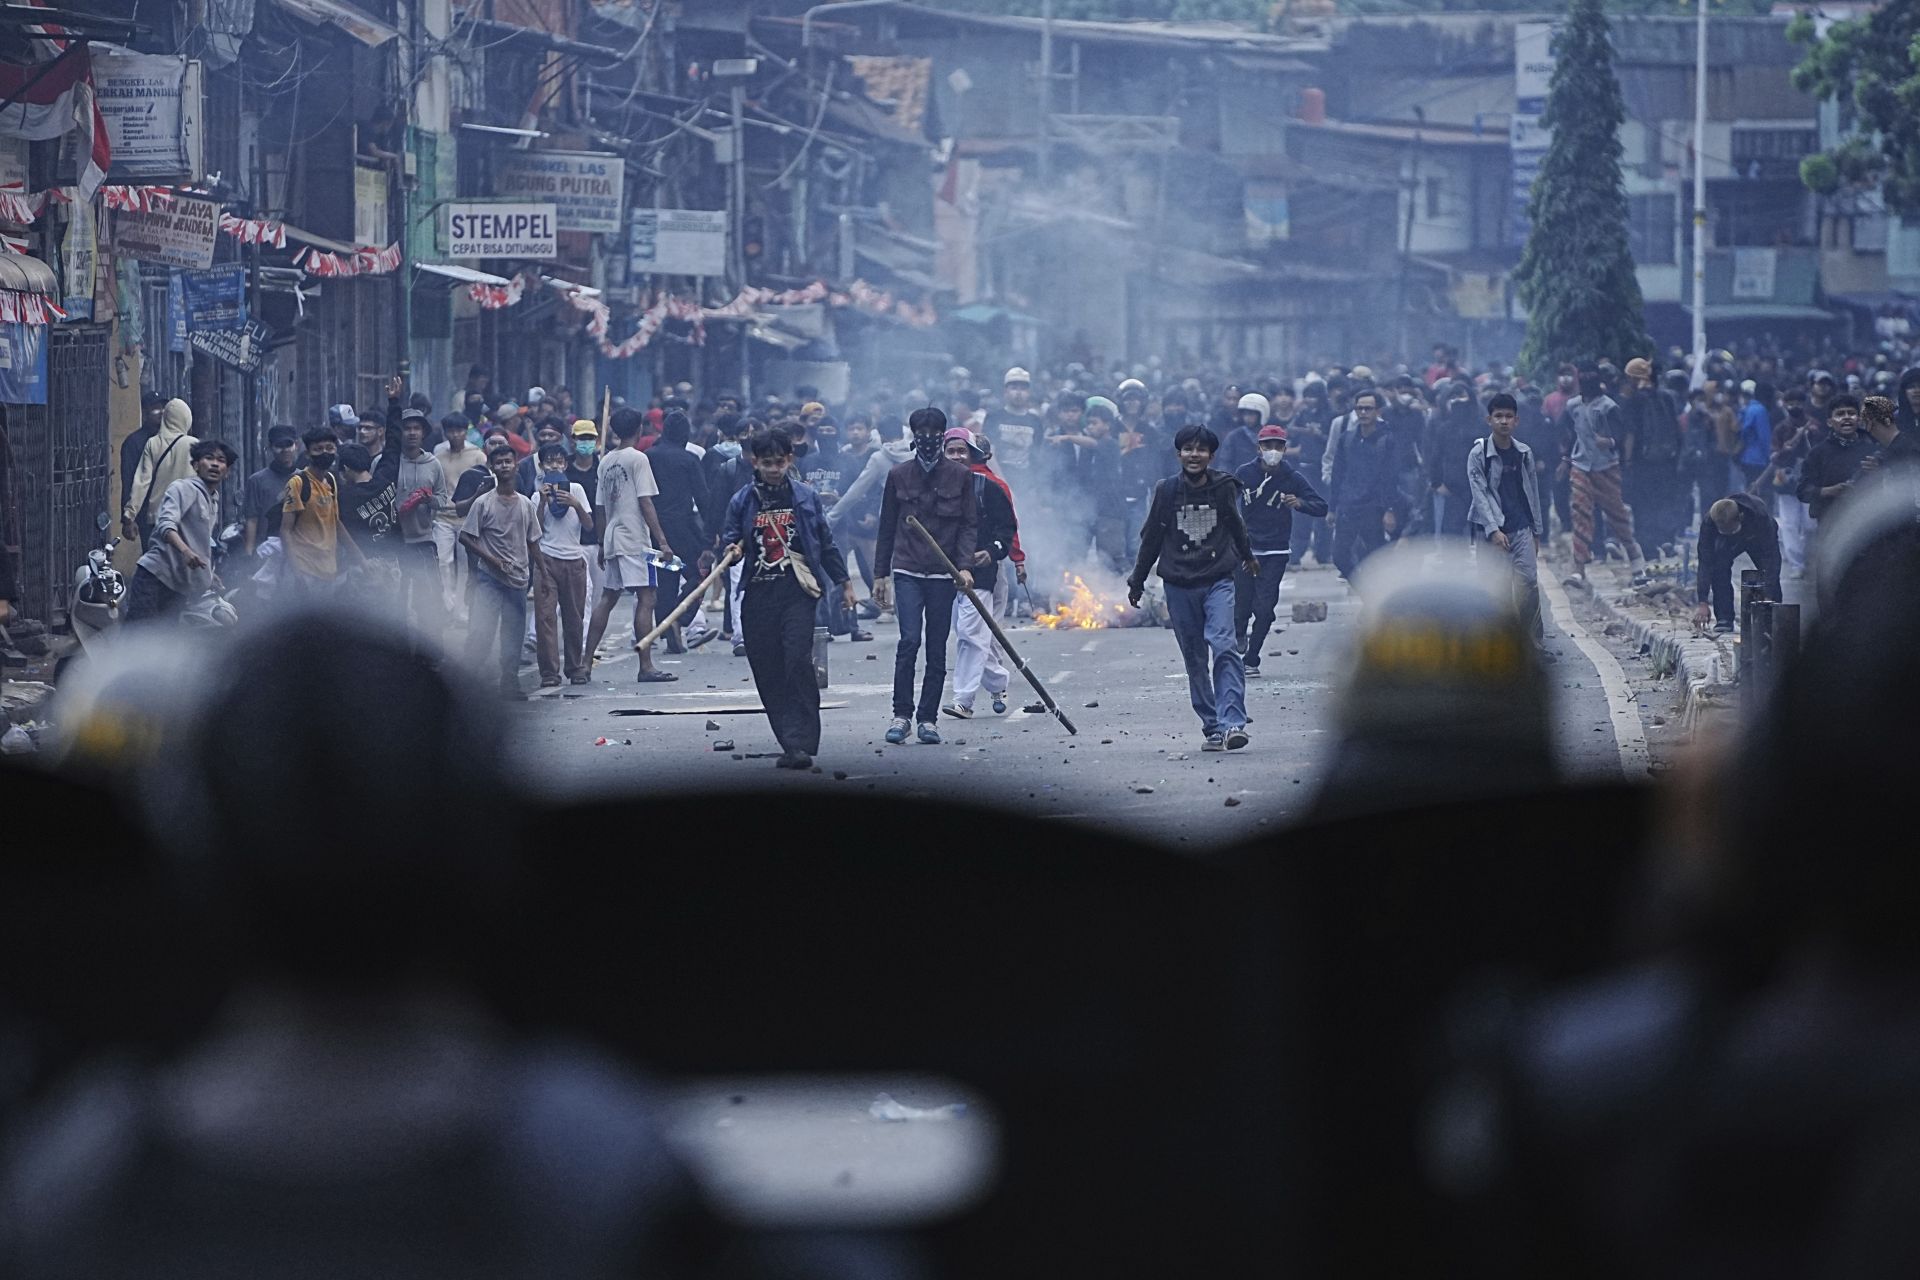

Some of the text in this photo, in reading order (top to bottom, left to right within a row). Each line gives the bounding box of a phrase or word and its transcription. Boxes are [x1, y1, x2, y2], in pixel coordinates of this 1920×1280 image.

[107, 79, 145, 87] BENGKEL
[96, 88, 134, 97] ERKAH
[579, 162, 606, 176] LAS
[504, 174, 612, 195] AGUNG PUTRA
[180, 200, 214, 220] JAYA
[173, 217, 214, 237] JENDELA
[451, 213, 553, 239] STEMPEL
[452, 243, 553, 254] CEPAT BISA DITUNGGU
